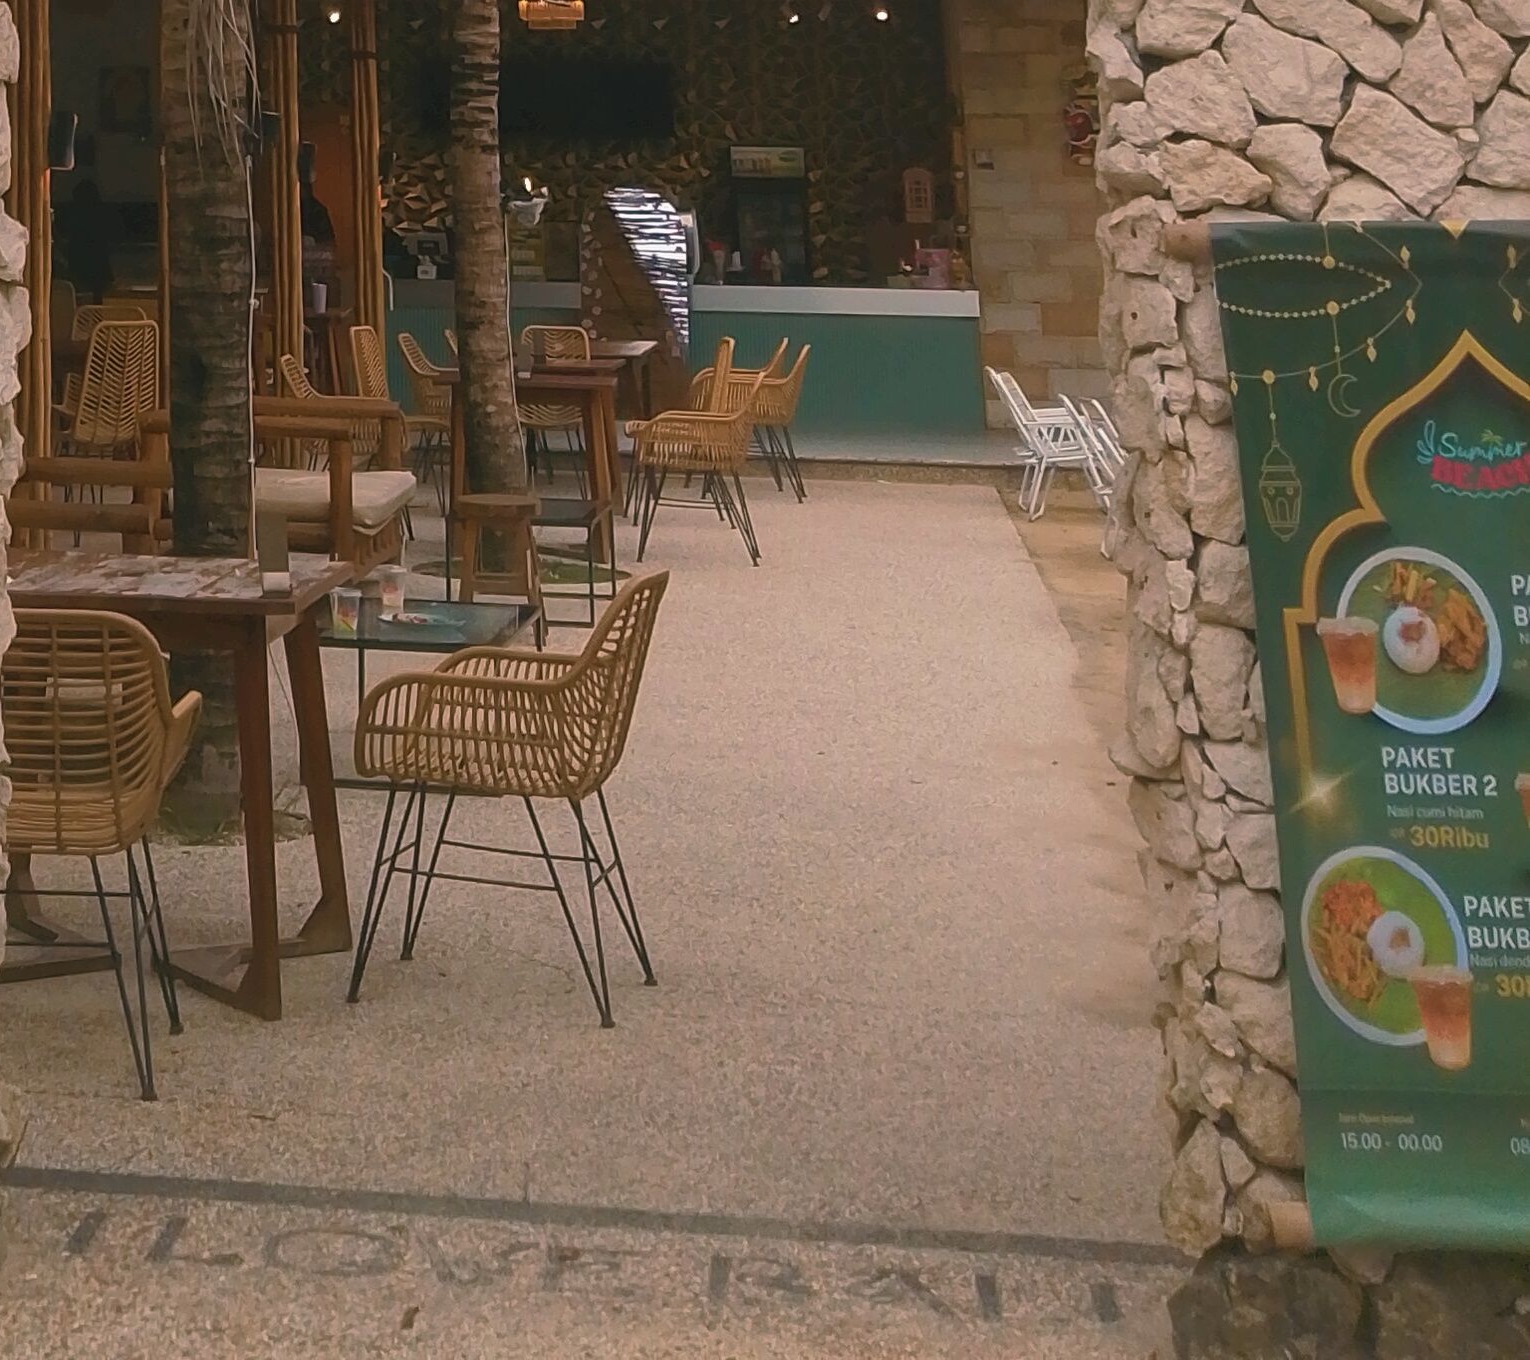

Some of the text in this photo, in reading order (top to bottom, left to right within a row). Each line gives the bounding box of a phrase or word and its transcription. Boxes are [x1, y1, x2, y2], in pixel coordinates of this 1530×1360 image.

[1437, 431, 1528, 462] Summer
[1381, 745, 1455, 769] PAKET
[1384, 773, 1499, 797] BUKBER 2
